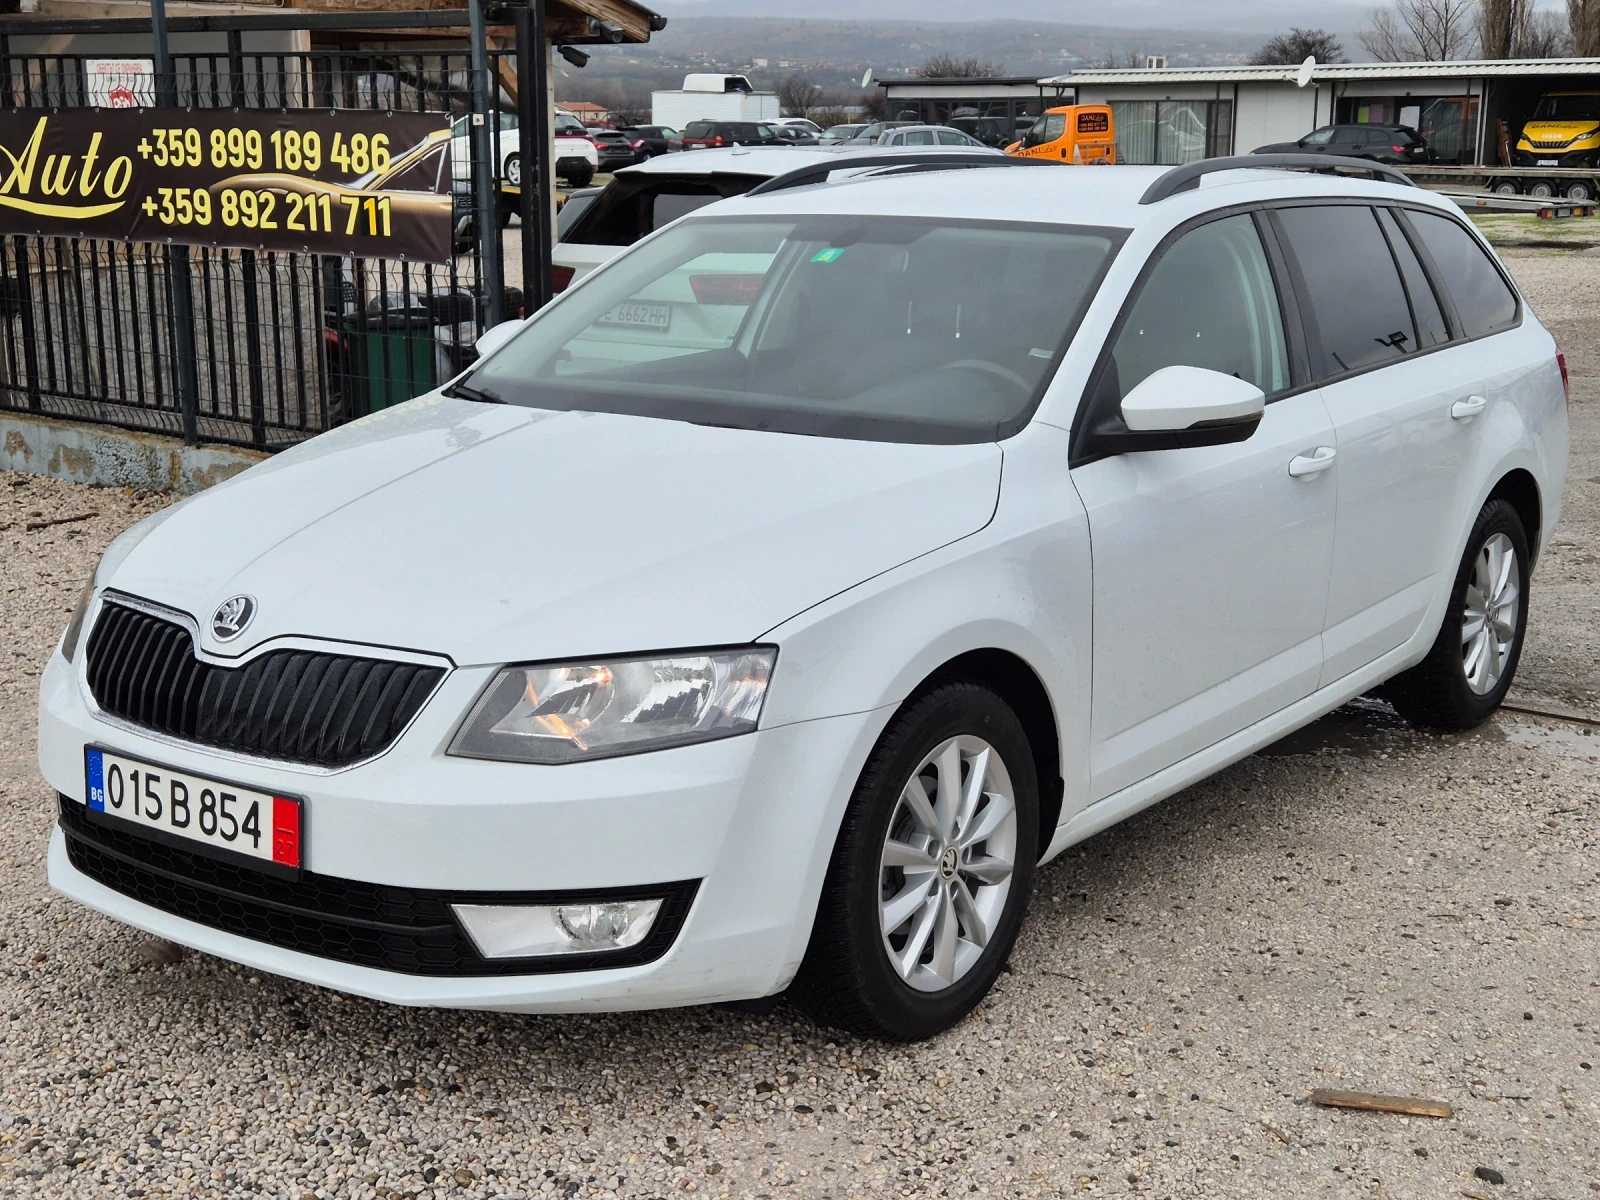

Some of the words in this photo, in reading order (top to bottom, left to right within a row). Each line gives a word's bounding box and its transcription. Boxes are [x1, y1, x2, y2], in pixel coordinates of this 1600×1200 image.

[0, 116, 133, 198] Auto
[137, 127, 202, 167] +359
[210, 127, 263, 169] 899
[270, 130, 322, 171] 189
[330, 132, 390, 174] 486
[1018, 147, 1041, 157] DANI
[142, 187, 212, 226] +359
[221, 188, 278, 228] 892
[286, 192, 332, 232] 211
[341, 195, 391, 236] 711
[618, 305, 648, 322] 6662
[91, 786, 103, 803] BG
[198, 788, 261, 849] 854
